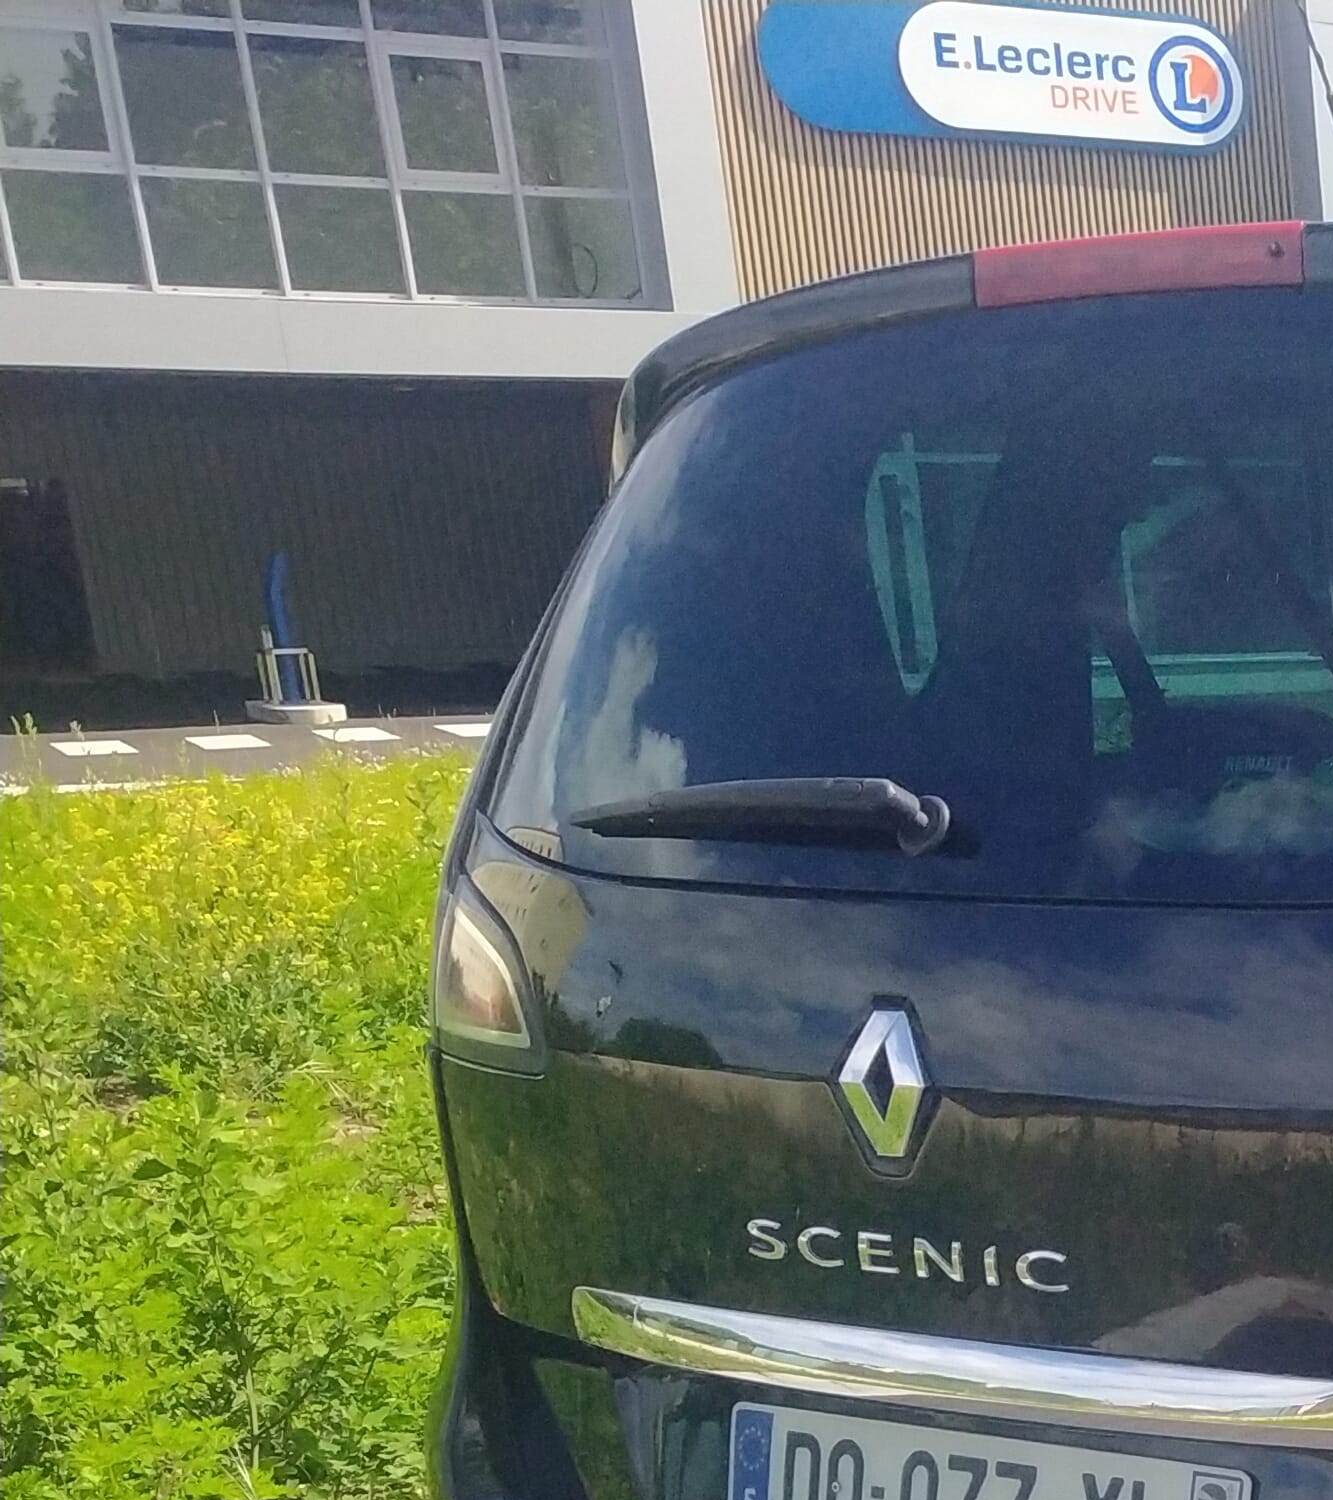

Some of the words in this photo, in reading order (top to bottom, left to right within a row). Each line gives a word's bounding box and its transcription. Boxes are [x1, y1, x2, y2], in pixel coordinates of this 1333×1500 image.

[932, 31, 1137, 83] E.Leclerc
[1050, 84, 1141, 116] DRIVE
[746, 1218, 1070, 1293] SCENIC
